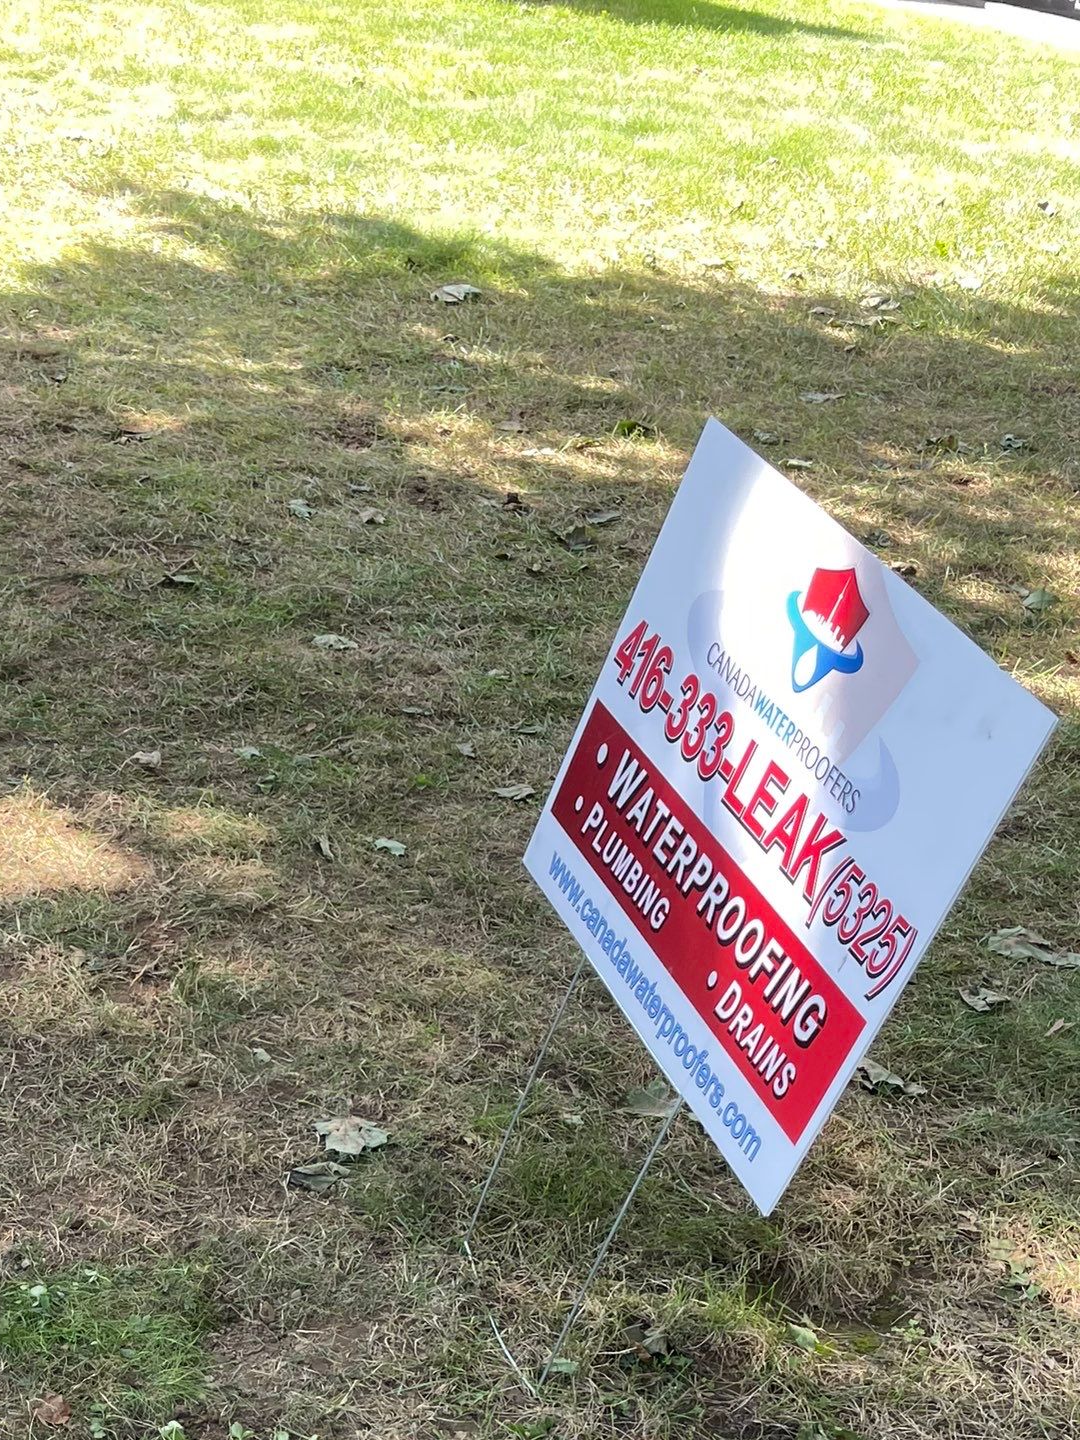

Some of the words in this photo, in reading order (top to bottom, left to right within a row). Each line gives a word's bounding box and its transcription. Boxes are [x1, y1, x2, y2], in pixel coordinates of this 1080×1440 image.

[706, 642, 861, 815] CANADAWATERPROOFERS
[581, 801, 671, 931] PLUMBING
[606, 748, 828, 1046] WATERPROOFING
[549, 851, 762, 1163] www.canadawaterproofers.com
[715, 980, 797, 1097] DRAINS
